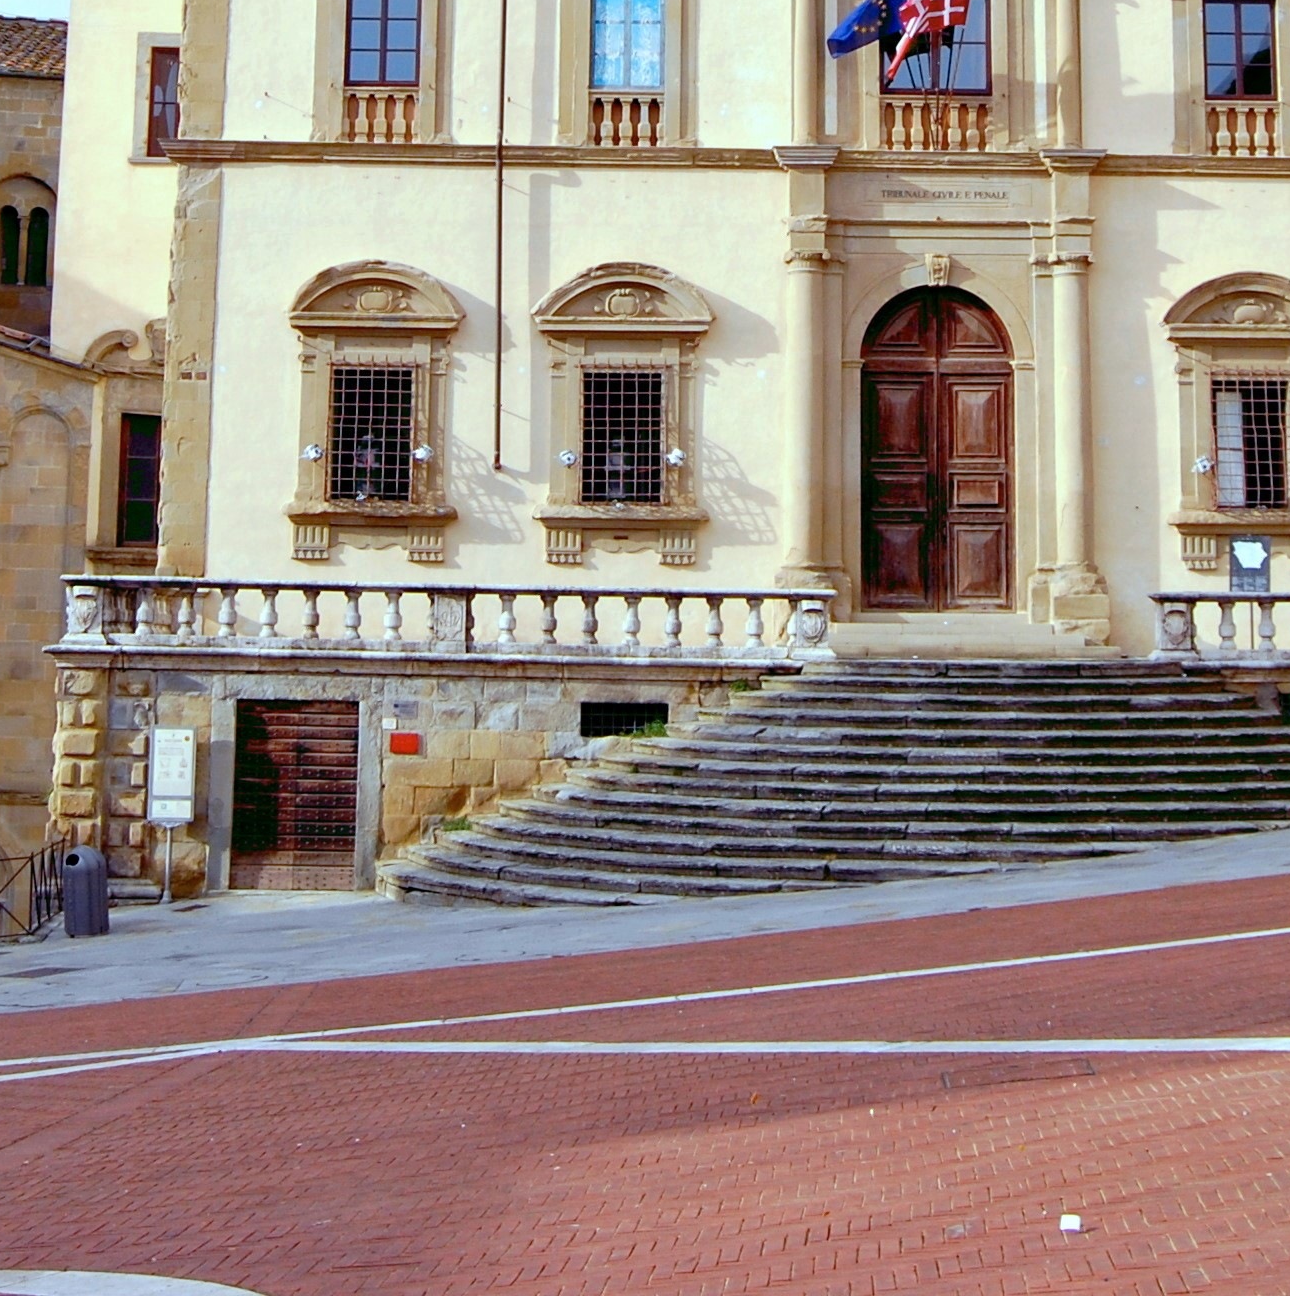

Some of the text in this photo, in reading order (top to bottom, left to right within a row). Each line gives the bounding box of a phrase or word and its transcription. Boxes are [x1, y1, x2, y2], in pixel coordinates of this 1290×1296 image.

[881, 189, 929, 199] TRIBUNALE
[932, 190, 963, 200] CIVILE
[973, 191, 1008, 200] PENALE
